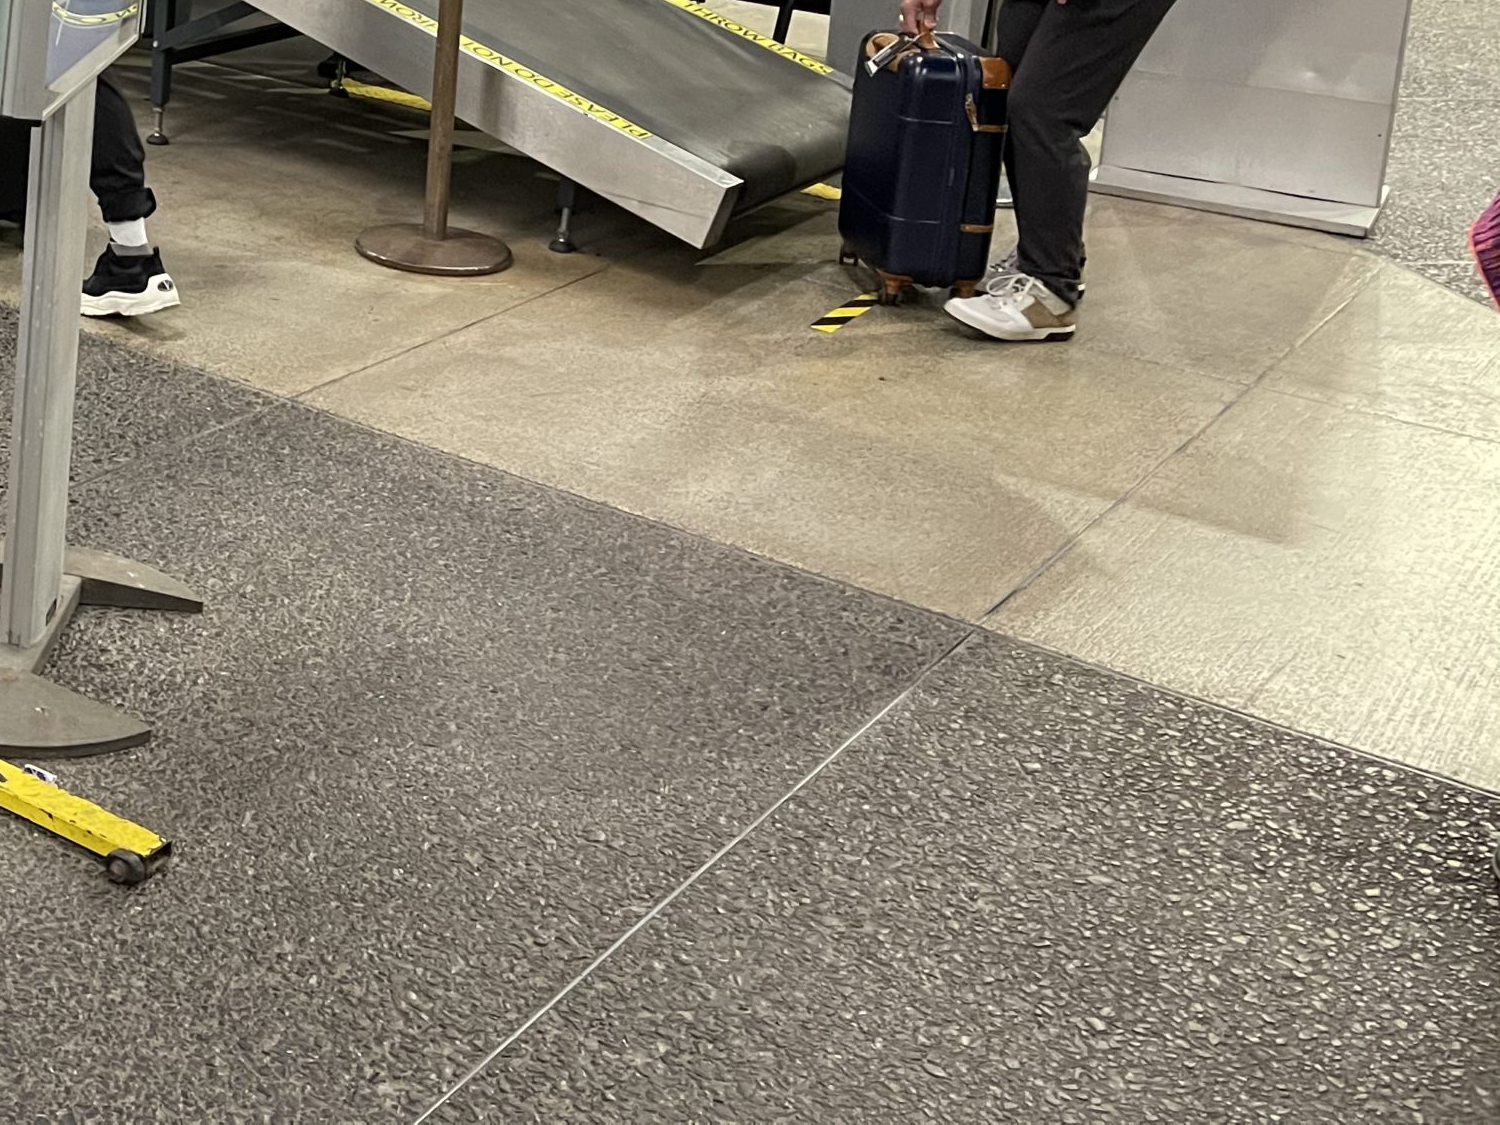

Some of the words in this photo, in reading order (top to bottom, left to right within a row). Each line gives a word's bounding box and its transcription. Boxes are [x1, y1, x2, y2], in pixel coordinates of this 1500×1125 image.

[463, 41, 513, 67] NOT
[684, 2, 766, 42] THROW
[767, 43, 828, 74] BAGS
[515, 67, 555, 90] DO
[560, 90, 652, 140] PLEASE
